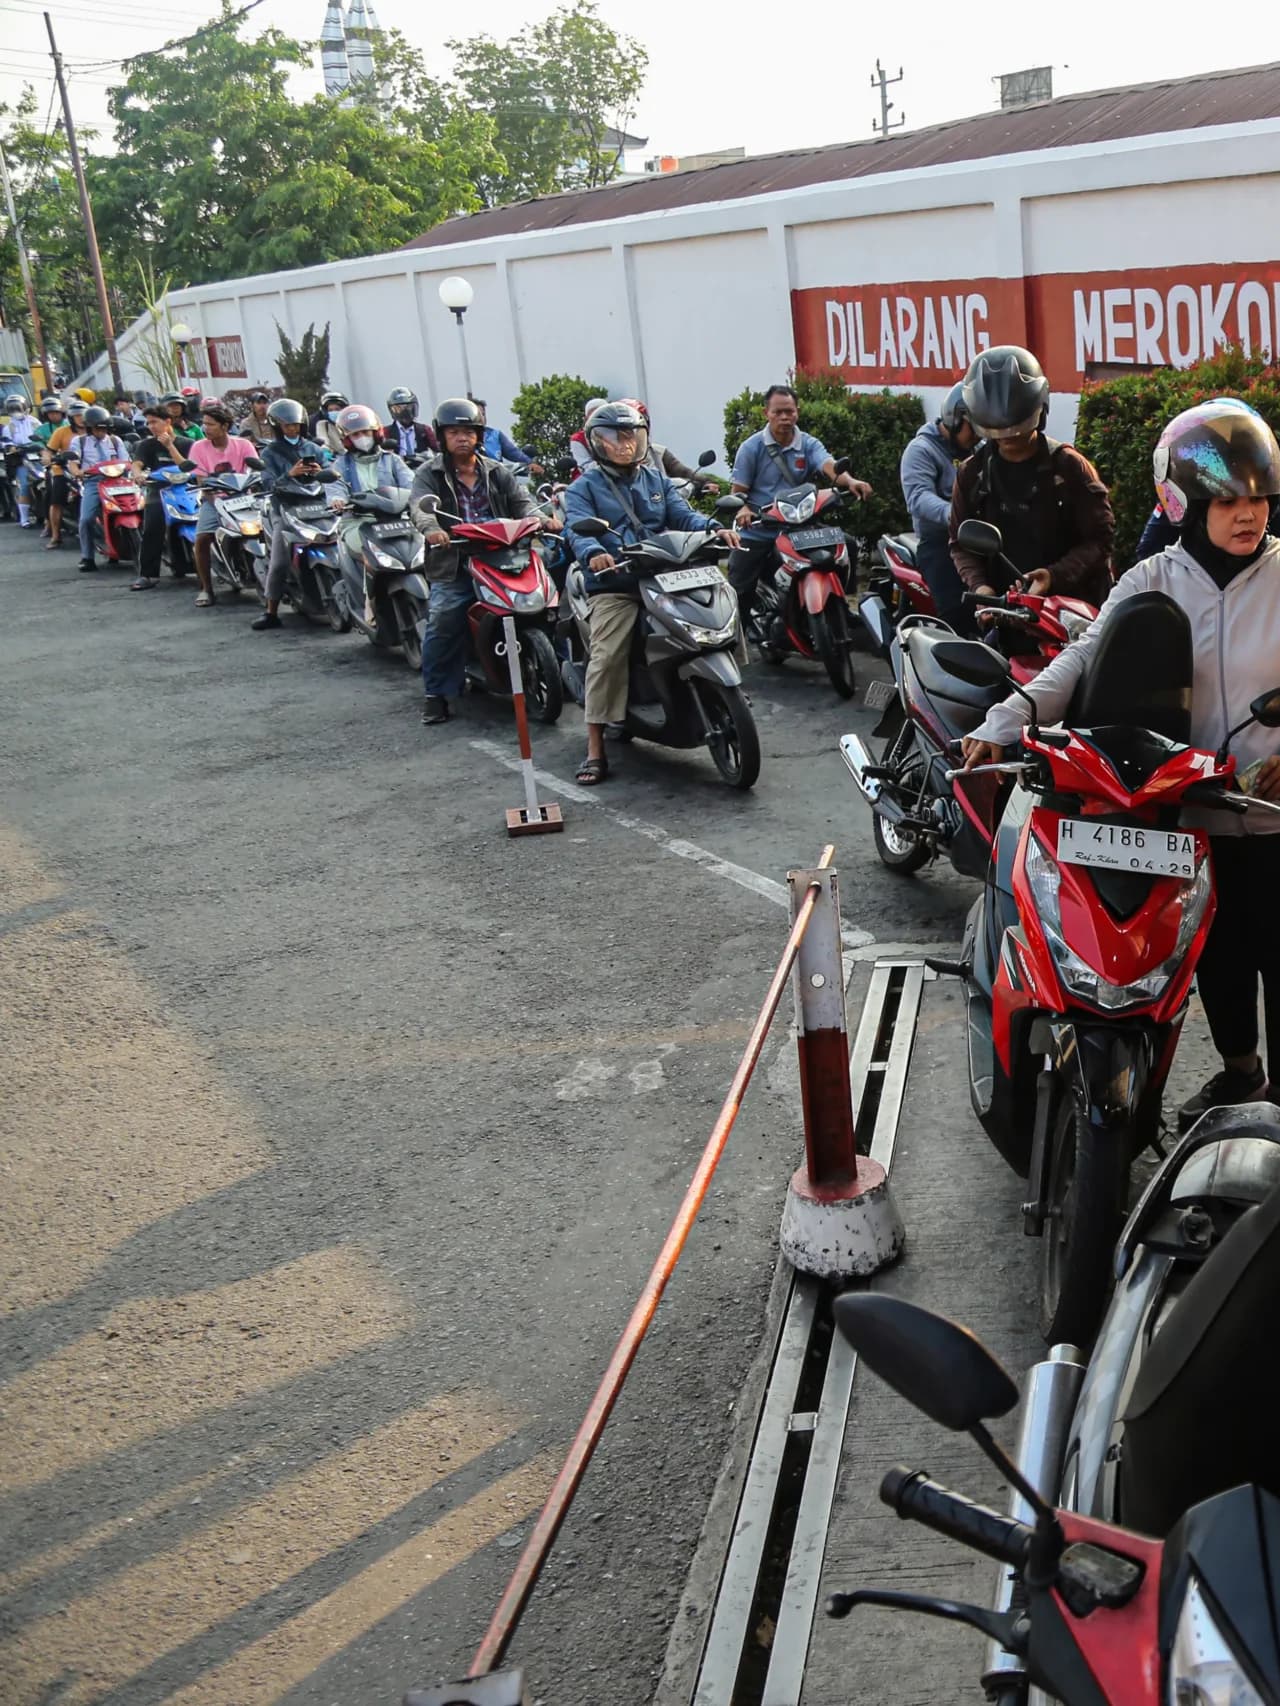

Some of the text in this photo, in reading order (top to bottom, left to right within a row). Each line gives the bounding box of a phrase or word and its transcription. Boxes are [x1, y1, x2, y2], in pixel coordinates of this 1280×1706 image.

[825, 293, 990, 370] DILARANG
[1062, 822, 1192, 854] H 4186 BA
